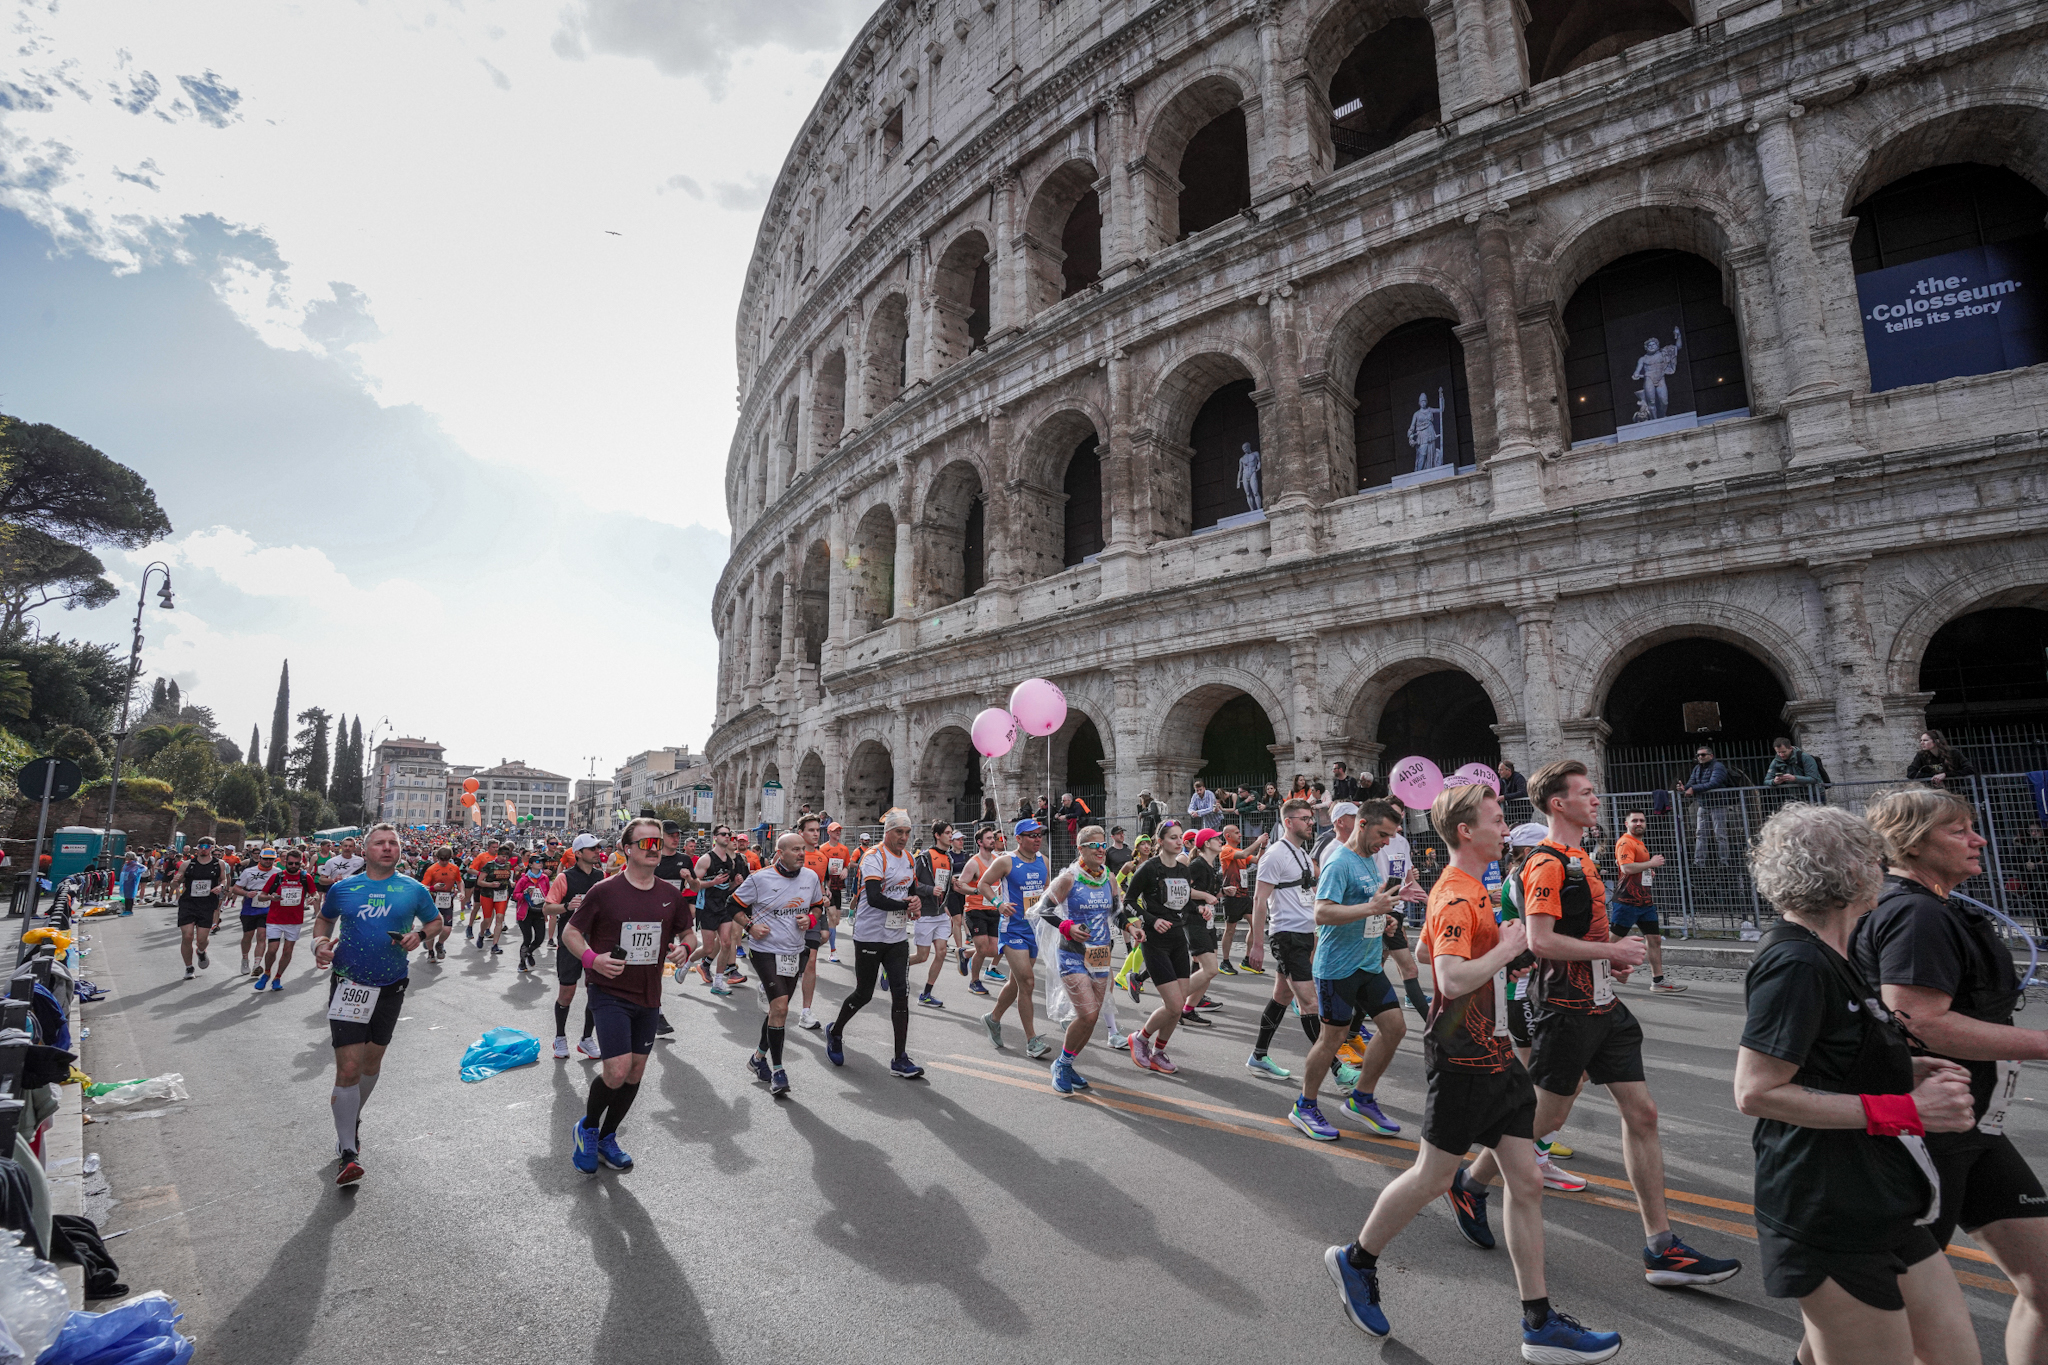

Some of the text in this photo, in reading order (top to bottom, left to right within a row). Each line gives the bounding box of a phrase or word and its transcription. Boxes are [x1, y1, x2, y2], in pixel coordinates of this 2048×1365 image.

[1884, 300, 2002, 334] tells its story
[1412, 773, 1427, 785] WAVE
[1170, 885, 1188, 898] F4405
[1535, 887, 1550, 898] 30
[367, 898, 386, 907] FUN
[356, 903, 393, 921] RUN
[1443, 925, 1462, 938] 30
[631, 932, 653, 947] 1775
[341, 987, 370, 1004] 5960
[353, 1007, 360, 1015] D
